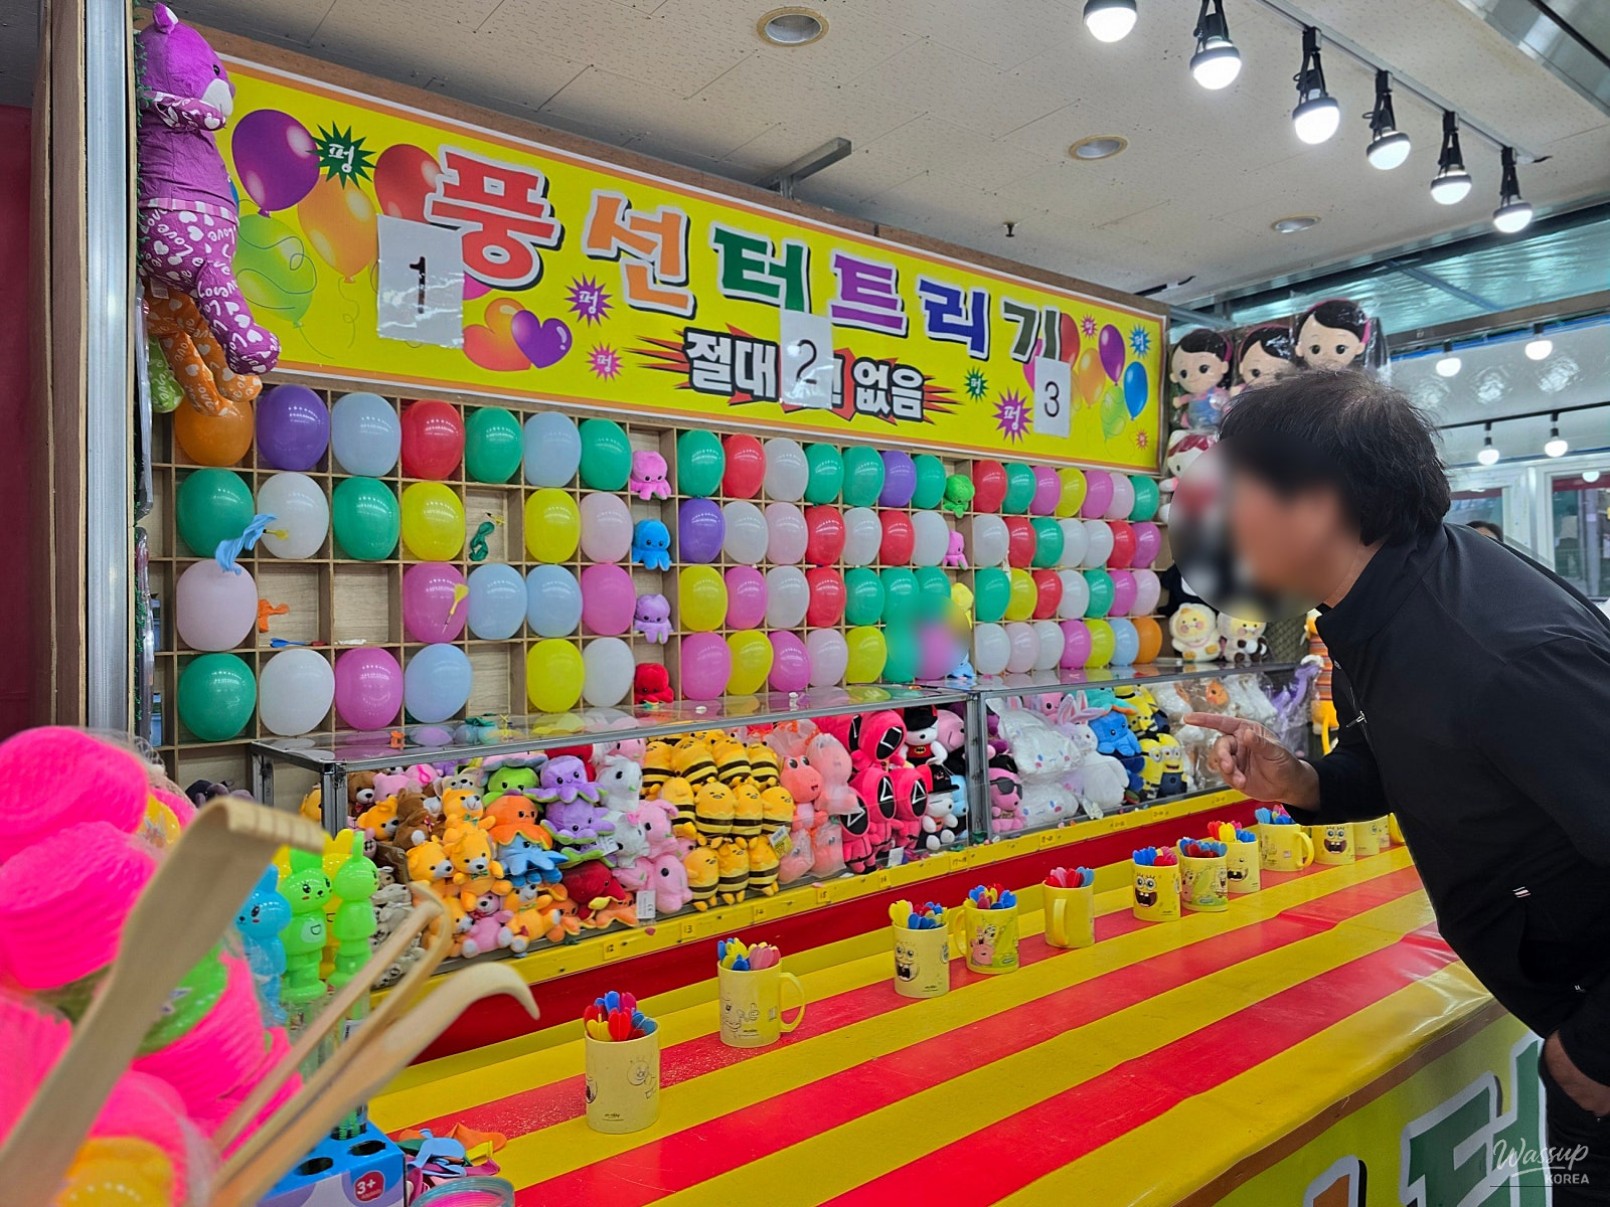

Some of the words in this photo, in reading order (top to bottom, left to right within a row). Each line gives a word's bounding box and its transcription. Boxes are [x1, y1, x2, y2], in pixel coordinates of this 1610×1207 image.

[408, 255, 427, 315] 1
[685, 330, 778, 401] 절대
[852, 358, 924, 420] 없음
[795, 338, 819, 386] 2
[1043, 381, 1060, 417] 3
[356, 1178, 377, 1195] 3+
